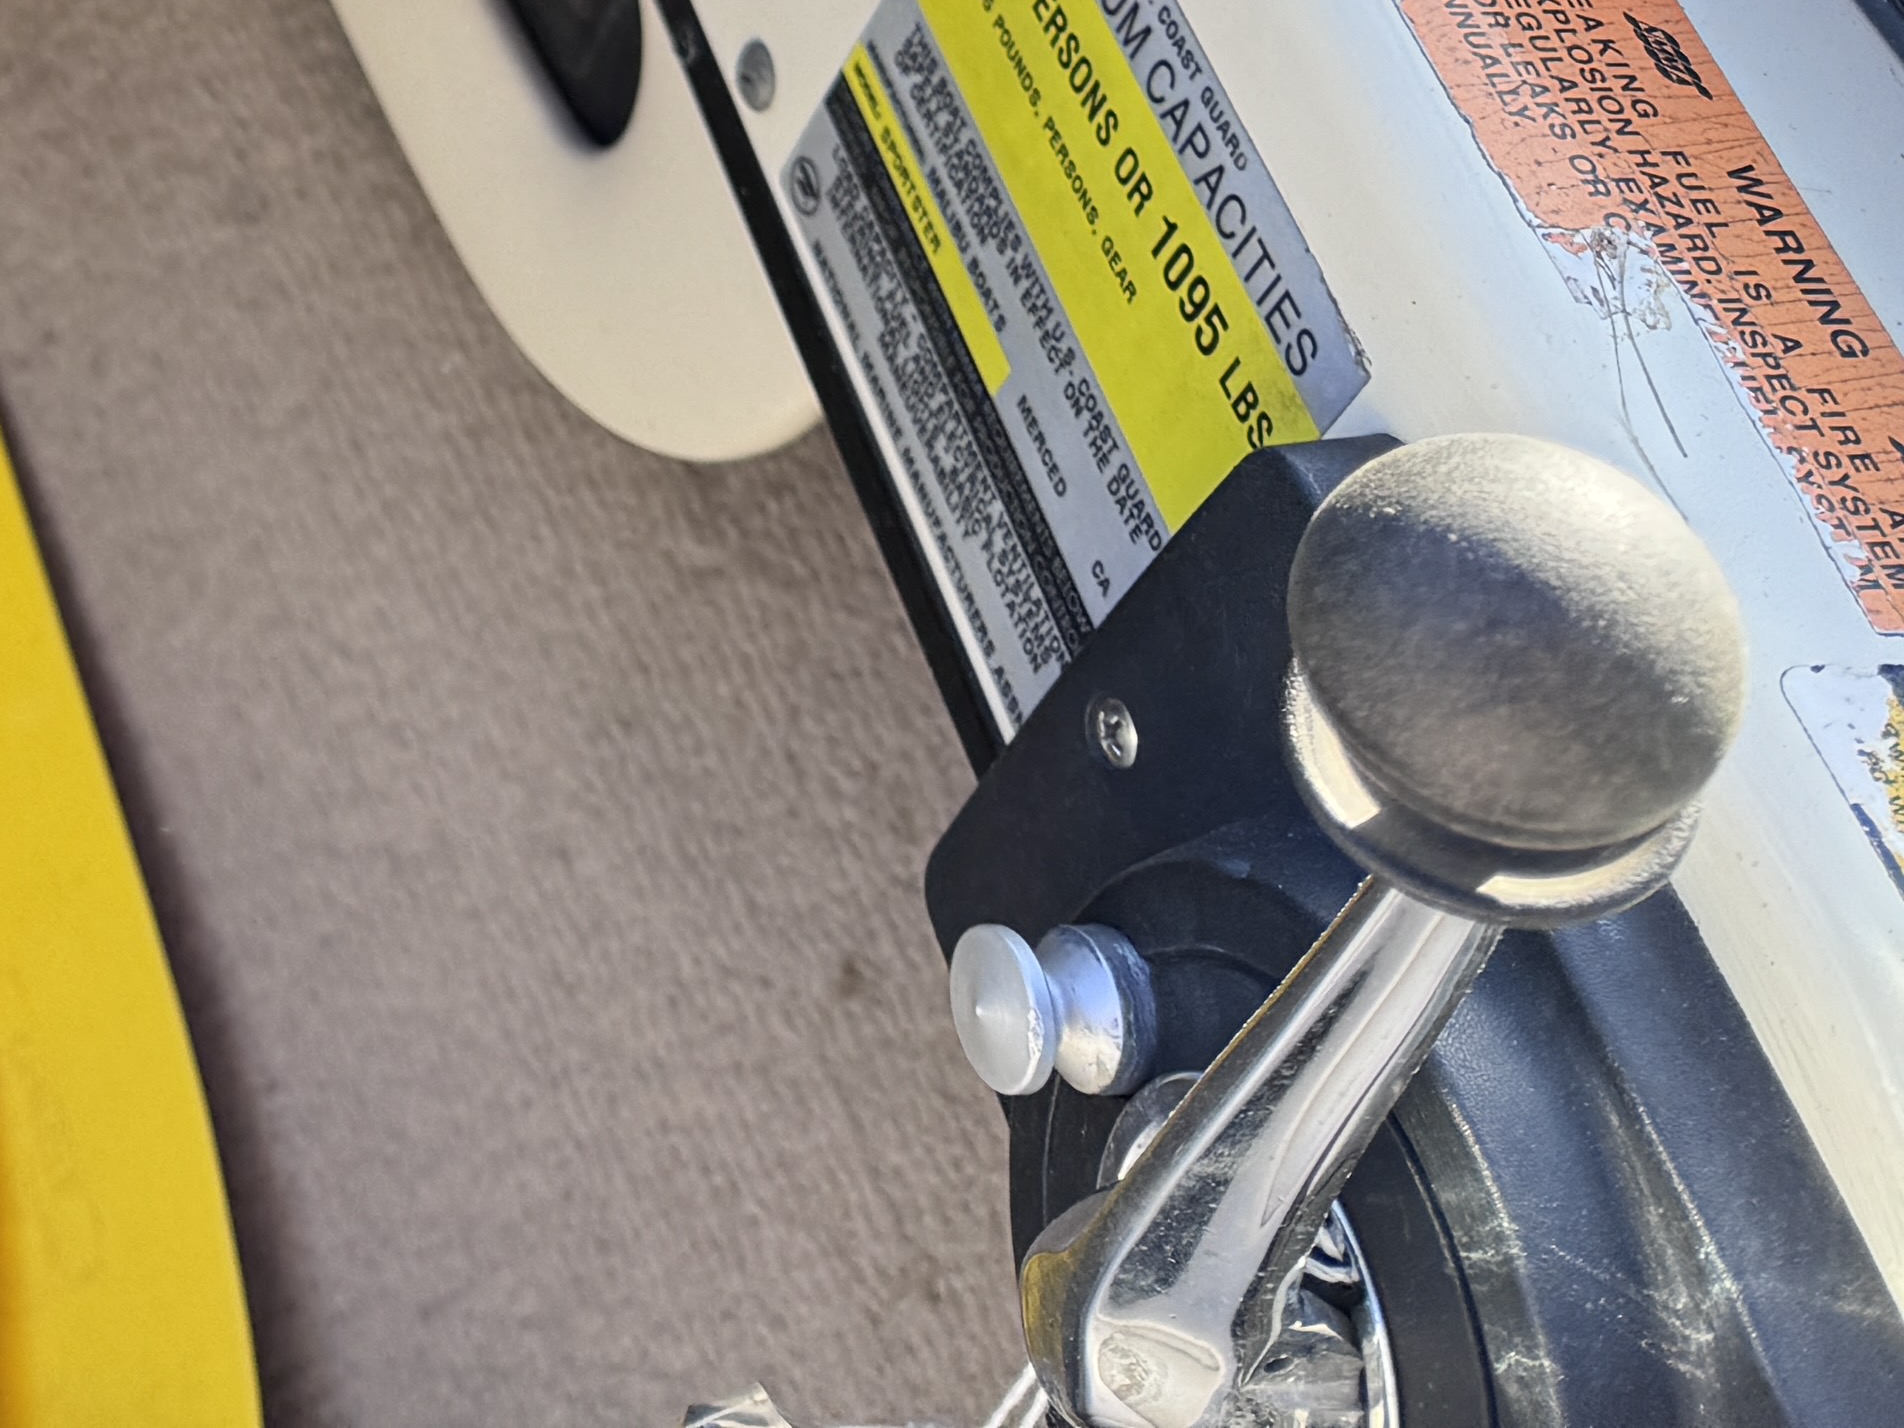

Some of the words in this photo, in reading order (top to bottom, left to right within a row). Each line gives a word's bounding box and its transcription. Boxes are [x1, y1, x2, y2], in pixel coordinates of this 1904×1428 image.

[909, 79, 989, 250] CERTIFICATION
[1155, 0, 1203, 87] COAST
[1198, 80, 1250, 177] GUARD
[1497, 42, 1580, 140] LEAKS
[1564, 154, 1613, 196] OR
[878, 123, 942, 257] SPORTSTER
[1097, 231, 1139, 307] GEAR
[1139, 47, 1321, 387] CAPACITIES
[1722, 164, 1875, 359] WARNING
[963, 133, 1022, 258] COMPLIES
[1018, 250, 1054, 324] WITH
[1076, 373, 1119, 462] COAST
[1116, 458, 1163, 556] GUARD
[966, 252, 1007, 337] BOATS
[1111, 140, 1156, 221] OR
[1144, 206, 1231, 365] 1095
[1216, 351, 1275, 458] LBS
[1626, 148, 1731, 283] HAZARD.
[1715, 297, 1825, 437] INSPECT
[1807, 449, 1904, 590] SYSTEM
[1659, 150, 1735, 237] FUEL
[1731, 269, 1775, 301] IS
[1770, 332, 1808, 355] A
[1804, 387, 1882, 473] FIRE
[1005, 253, 1023, 288] IN
[1019, 283, 1066, 381] EFFECT
[1062, 375, 1085, 421] ON
[1081, 418, 1110, 475] THE
[1106, 472, 1142, 547] DATE
[1015, 391, 1068, 502] MERCED
[1089, 555, 1112, 600] CA
[1768, 445, 1886, 592] SYSTM
